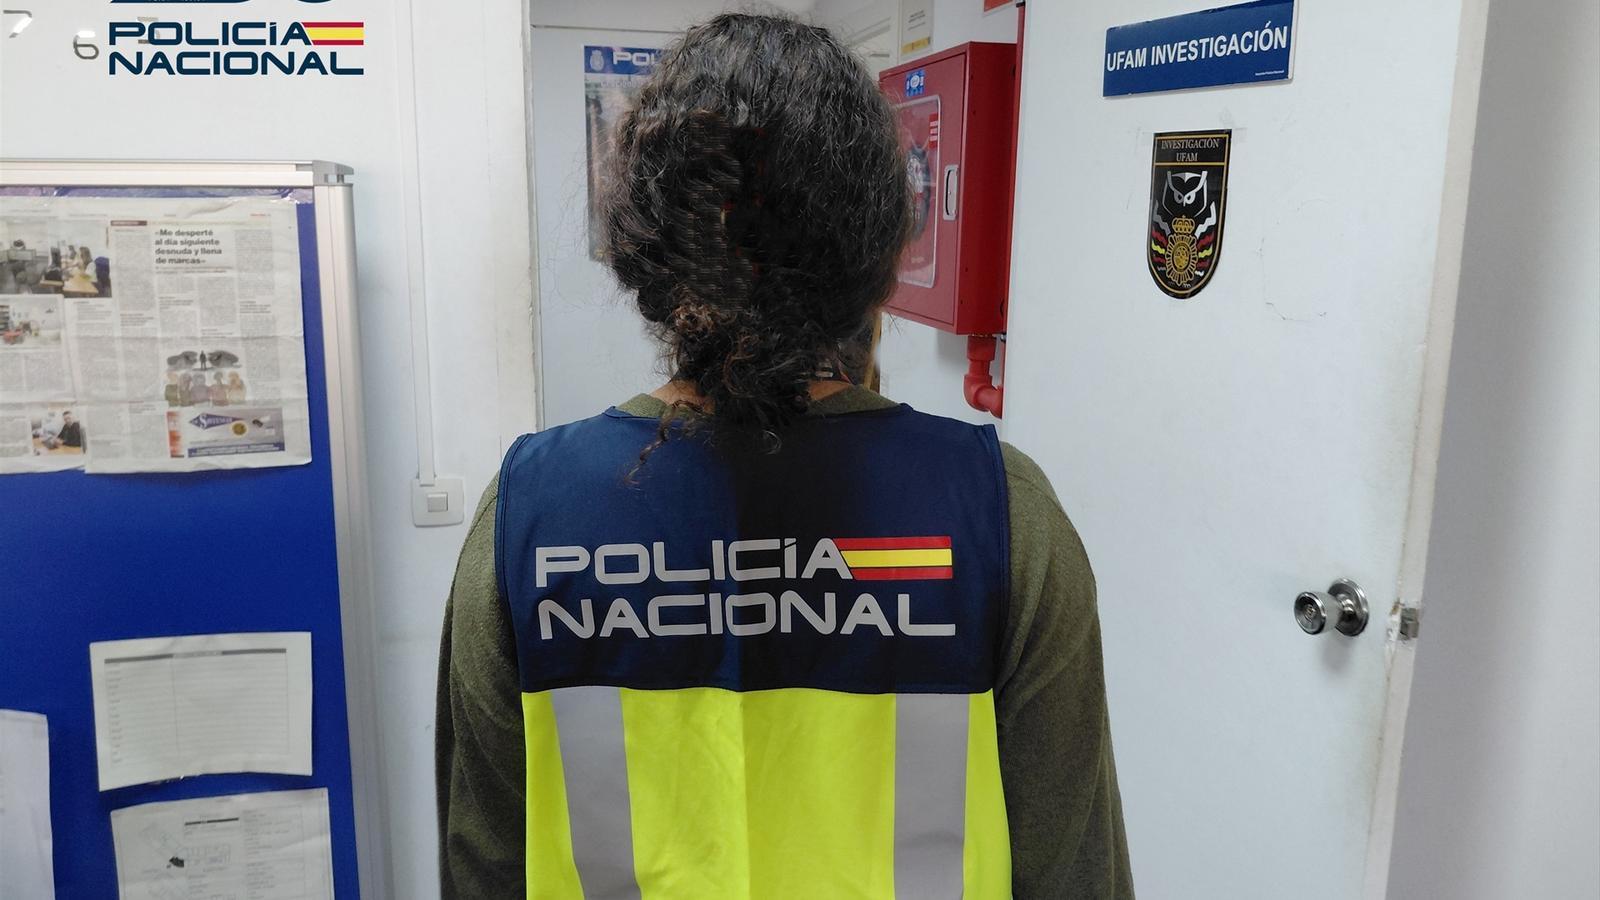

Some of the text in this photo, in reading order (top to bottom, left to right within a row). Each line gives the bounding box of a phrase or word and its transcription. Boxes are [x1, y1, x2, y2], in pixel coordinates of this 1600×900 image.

[1107, 21, 1288, 71] UFAM INVESTIGACIÓN
[1161, 138, 1220, 149] INVESTIGACIÓN
[1176, 152, 1198, 161] UFAM
[180, 239, 220, 247] siguiente
[536, 537, 853, 588] POLICÍA
[538, 590, 956, 640] NACIONAL
